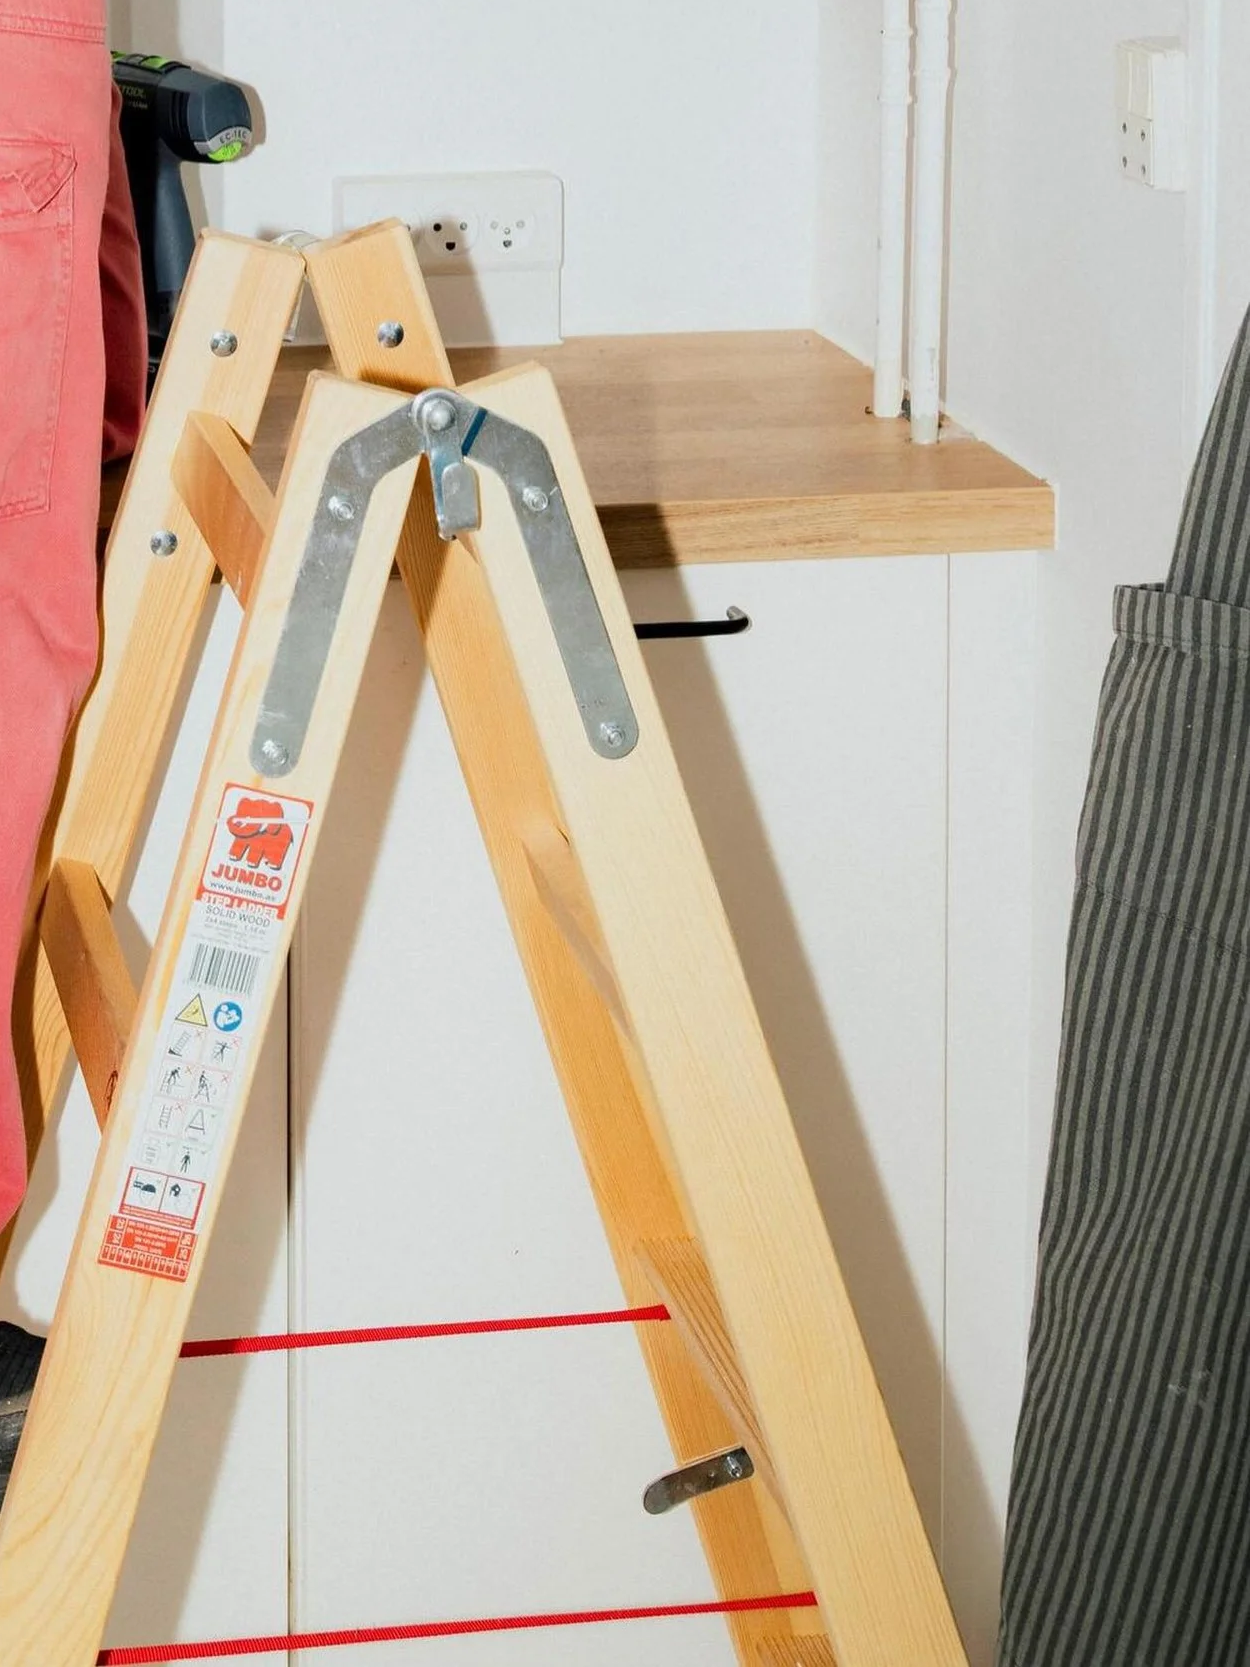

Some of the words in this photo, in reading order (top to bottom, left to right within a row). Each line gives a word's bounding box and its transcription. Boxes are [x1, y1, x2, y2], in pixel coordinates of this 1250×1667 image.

[219, 128, 248, 144] EC-TEC
[211, 863, 283, 892] JUMBO
[201, 892, 231, 908] STEP
[205, 905, 236, 919] SOLID
[239, 913, 271, 927] WOOD
